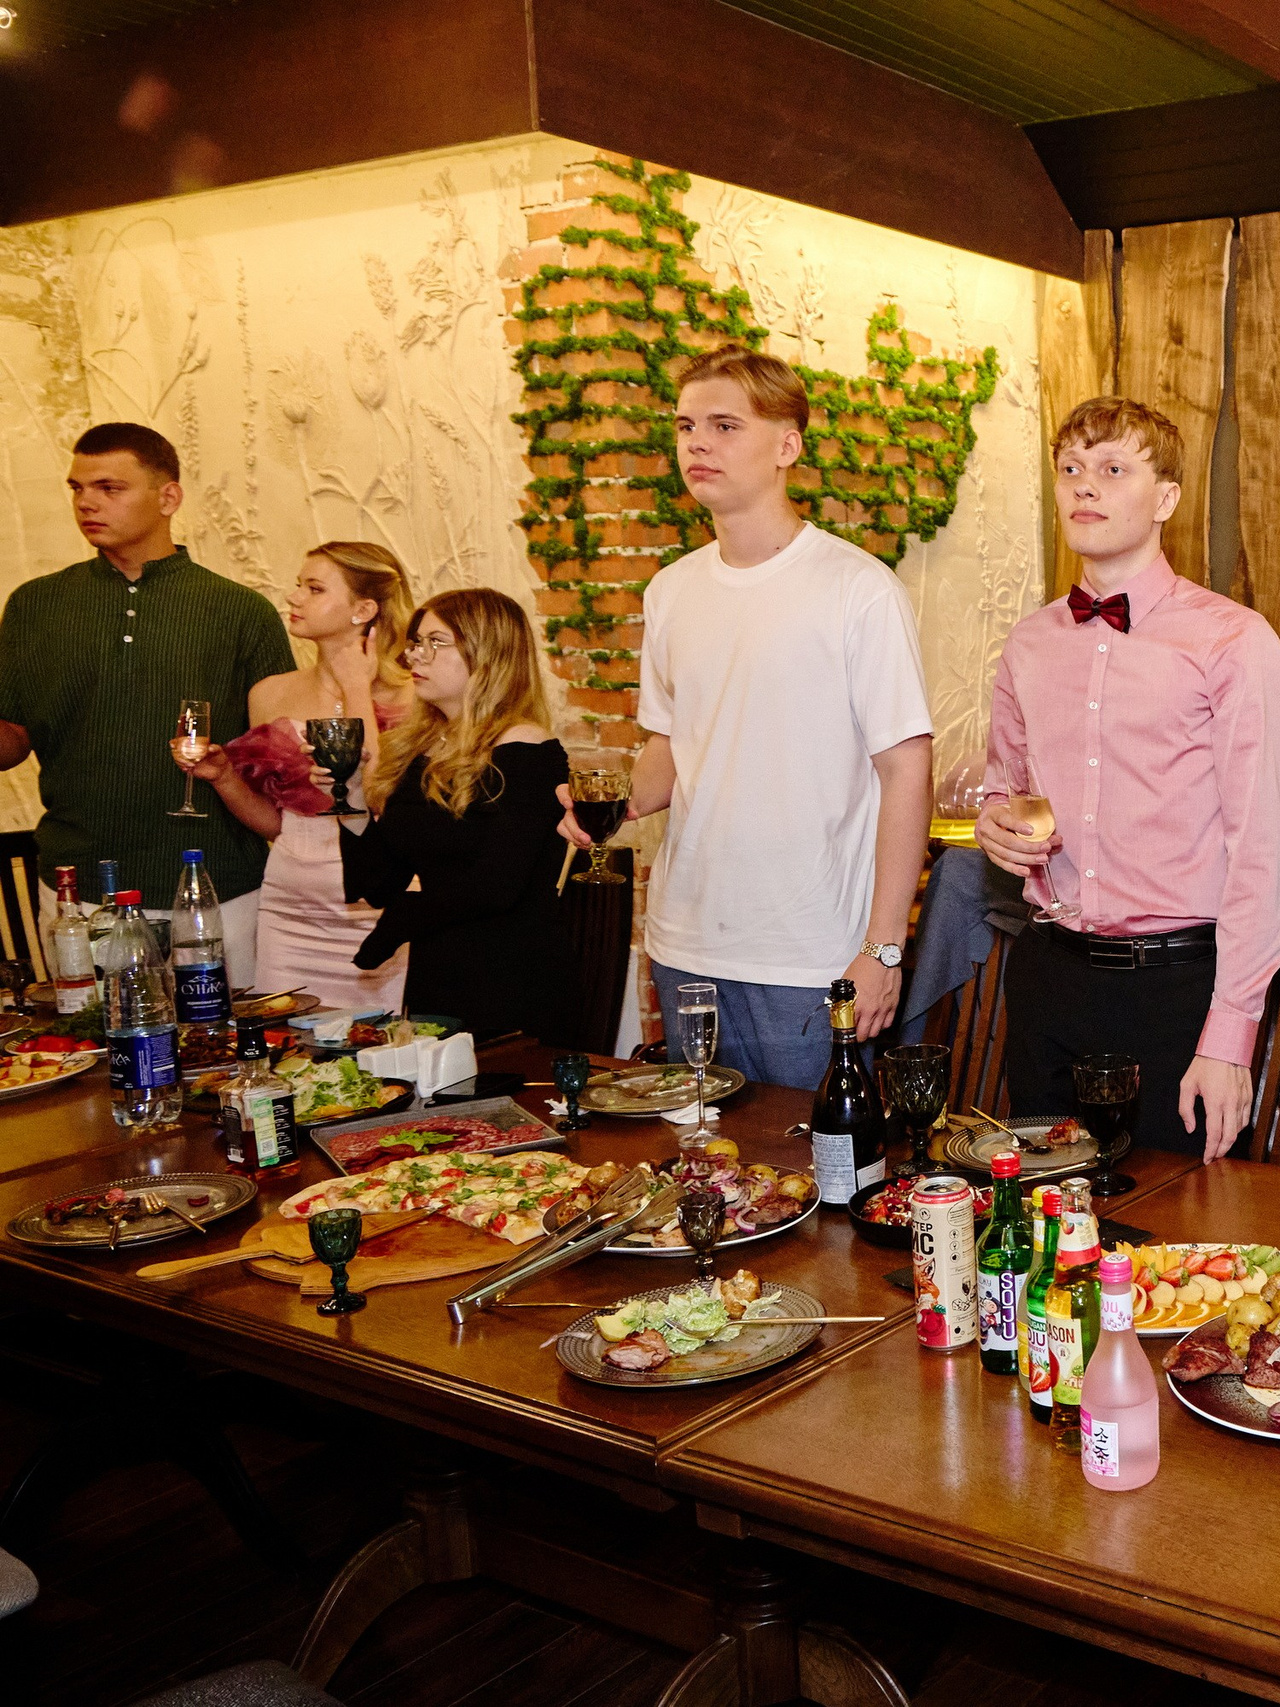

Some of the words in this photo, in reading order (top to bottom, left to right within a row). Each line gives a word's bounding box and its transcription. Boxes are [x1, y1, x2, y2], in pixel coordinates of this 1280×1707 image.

[912, 1219, 933, 1232] ТЕР
[1000, 1272, 1016, 1339] SOJU
[1047, 1321, 1075, 1343] ASON
[1094, 1427, 1110, 1465] 소주
